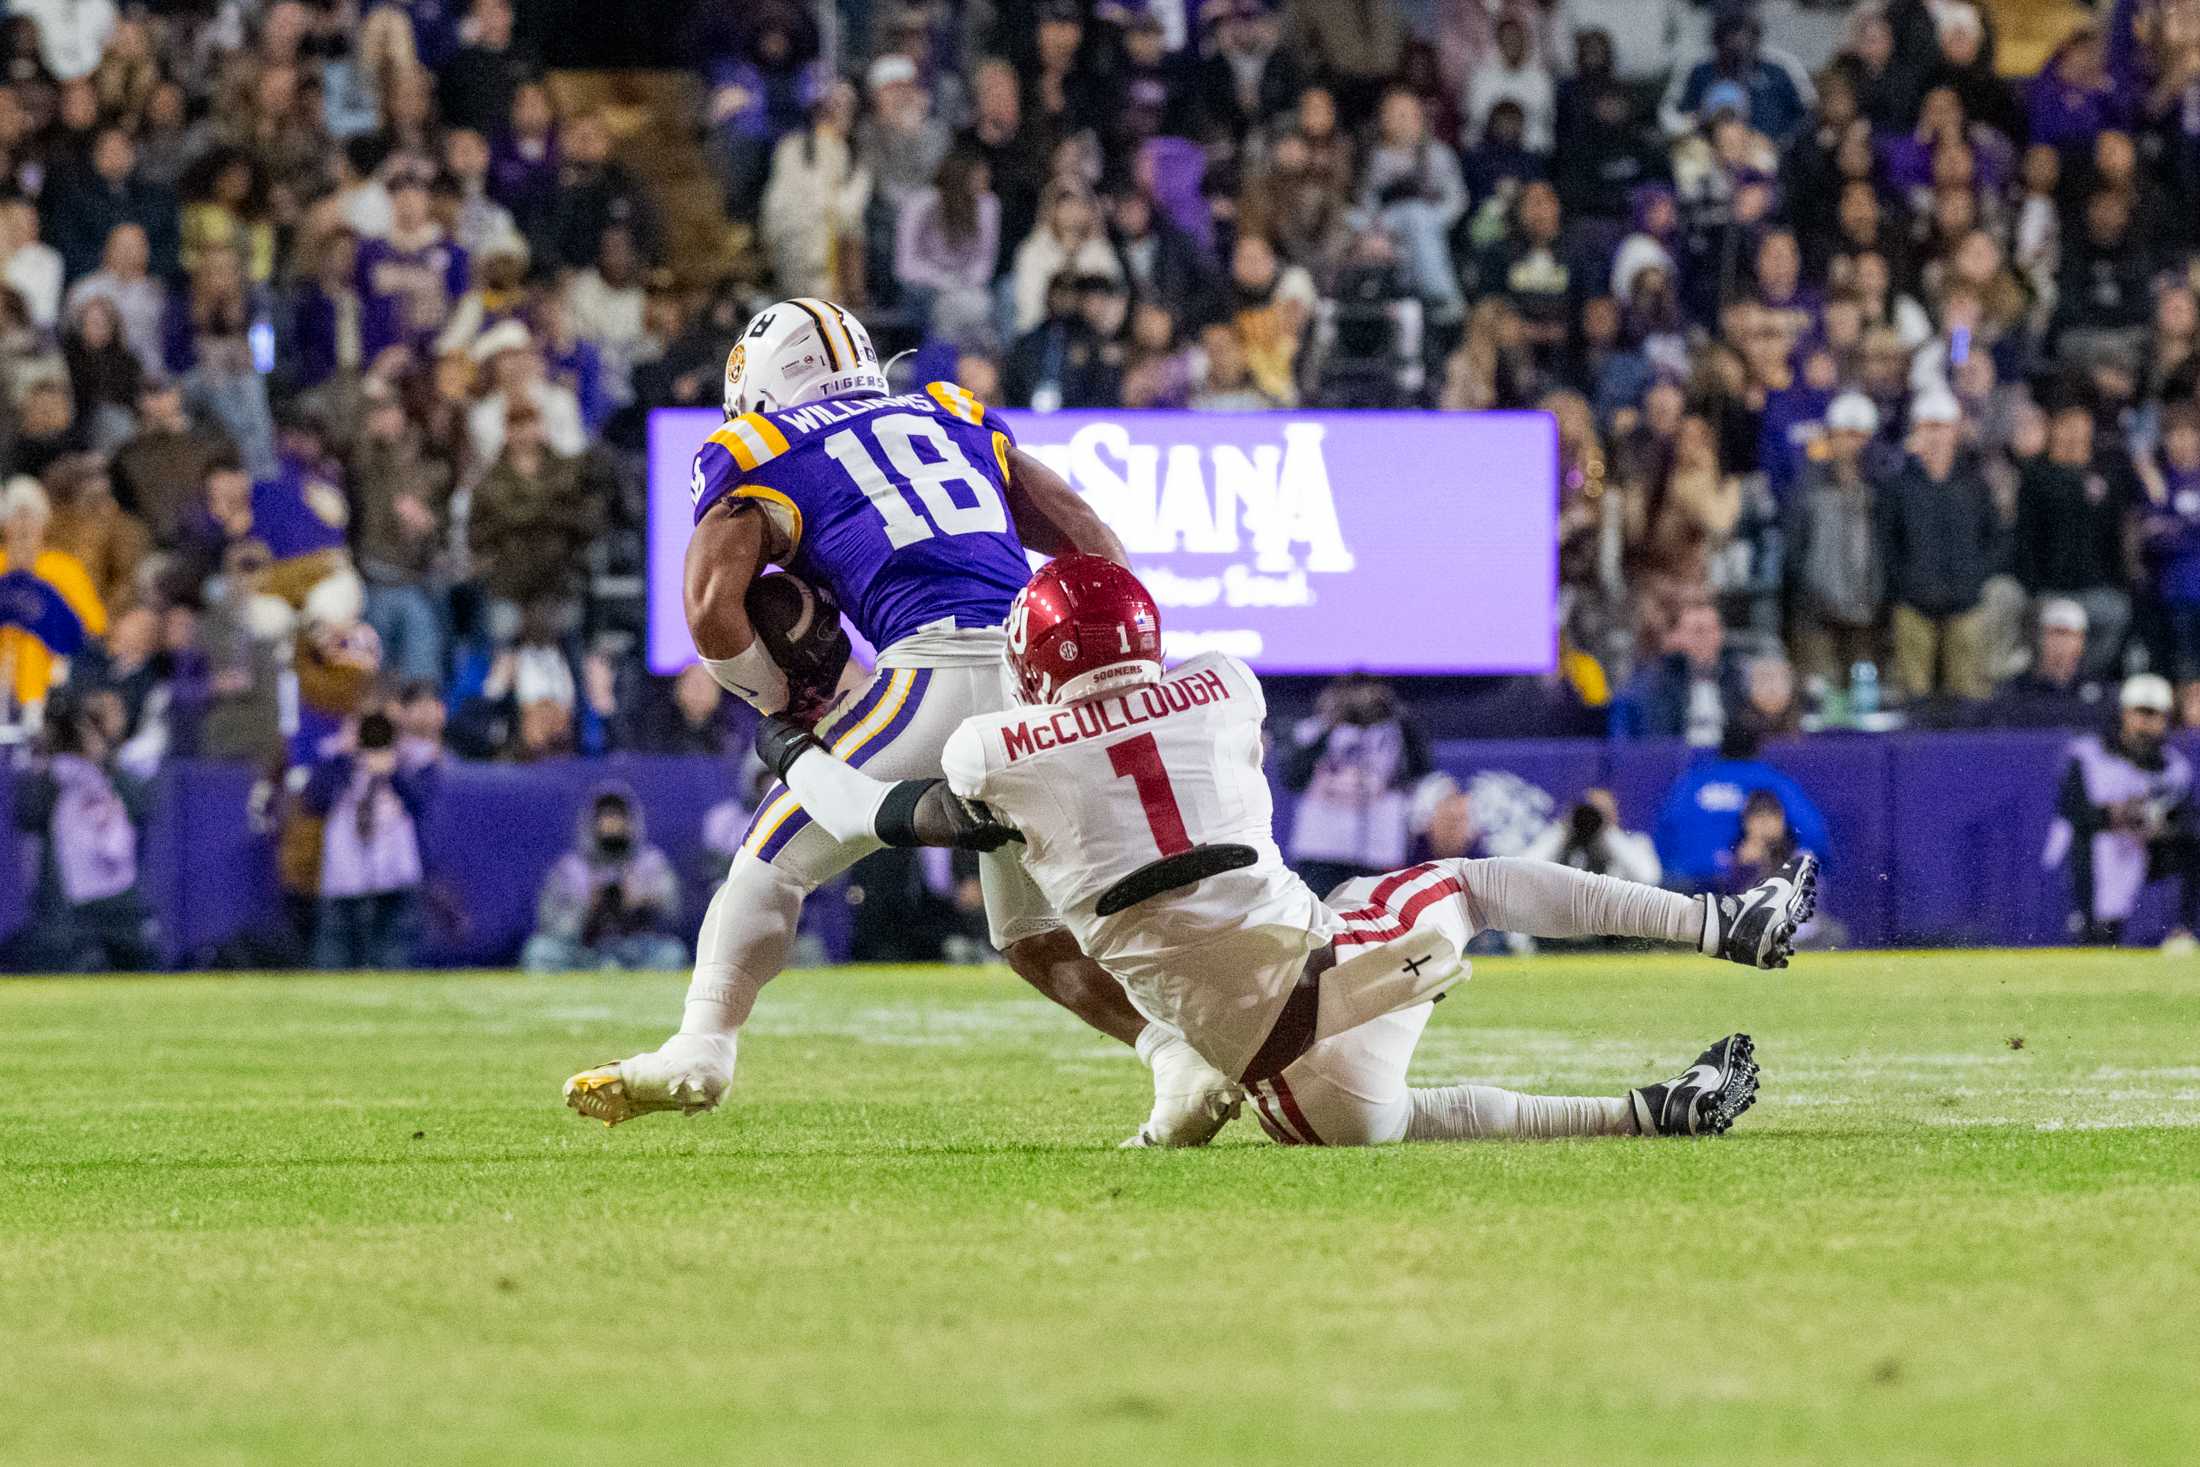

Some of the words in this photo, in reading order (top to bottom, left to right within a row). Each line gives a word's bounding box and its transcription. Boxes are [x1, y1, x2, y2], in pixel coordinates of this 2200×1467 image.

[778, 394, 936, 433] WILLIAMS
[820, 376, 885, 395] TIGERS
[824, 413, 1007, 550] 18
[1016, 422, 1355, 572] SIANA
[1116, 623, 1131, 653] 1
[1093, 665, 1142, 683] SOONERS
[1001, 669, 1230, 761] McCULLOUGH
[1105, 732, 1207, 857] 1
